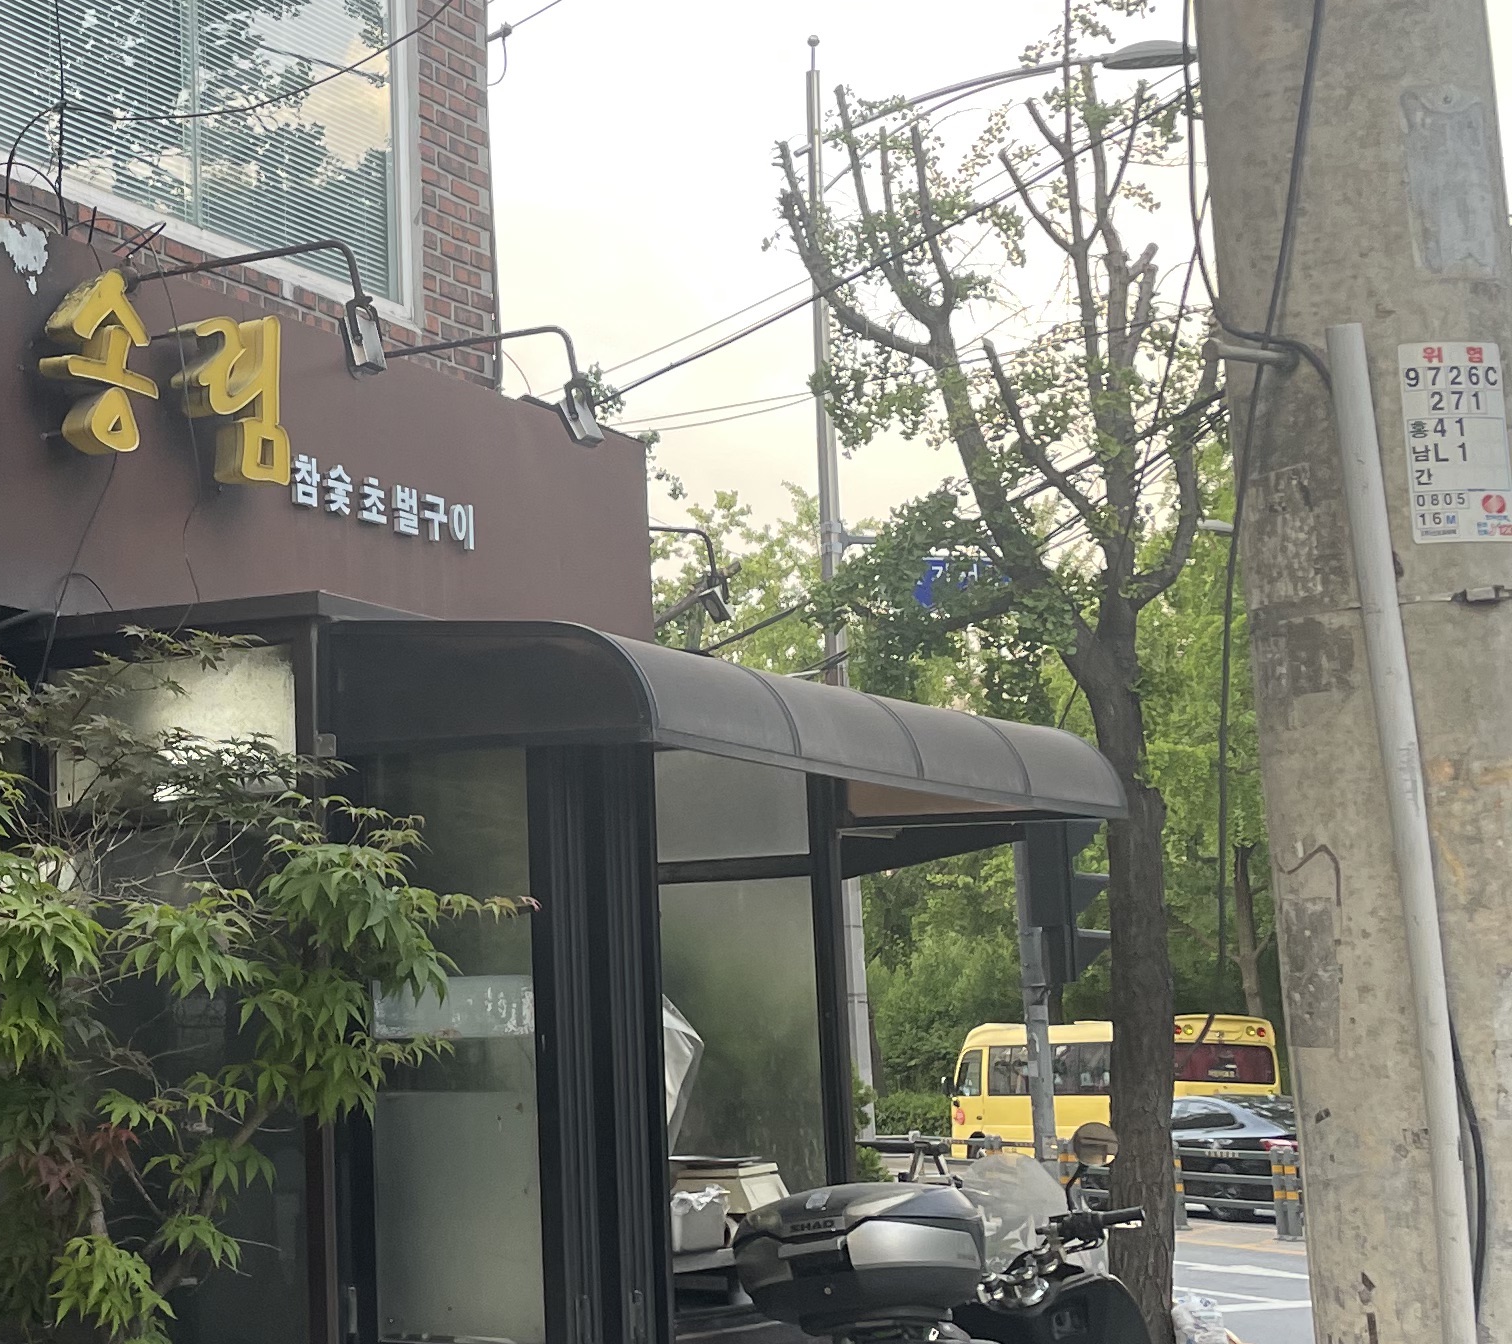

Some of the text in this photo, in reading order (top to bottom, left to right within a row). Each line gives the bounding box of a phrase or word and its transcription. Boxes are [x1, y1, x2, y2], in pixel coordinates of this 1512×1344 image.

[39, 268, 290, 486] 송림
[1405, 366, 1498, 387] 9726C
[1430, 391, 1481, 410] 271
[292, 454, 476, 550] 참숯초벌구이
[1416, 492, 1465, 507] 0805
[790, 1219, 836, 1233] SHAD
